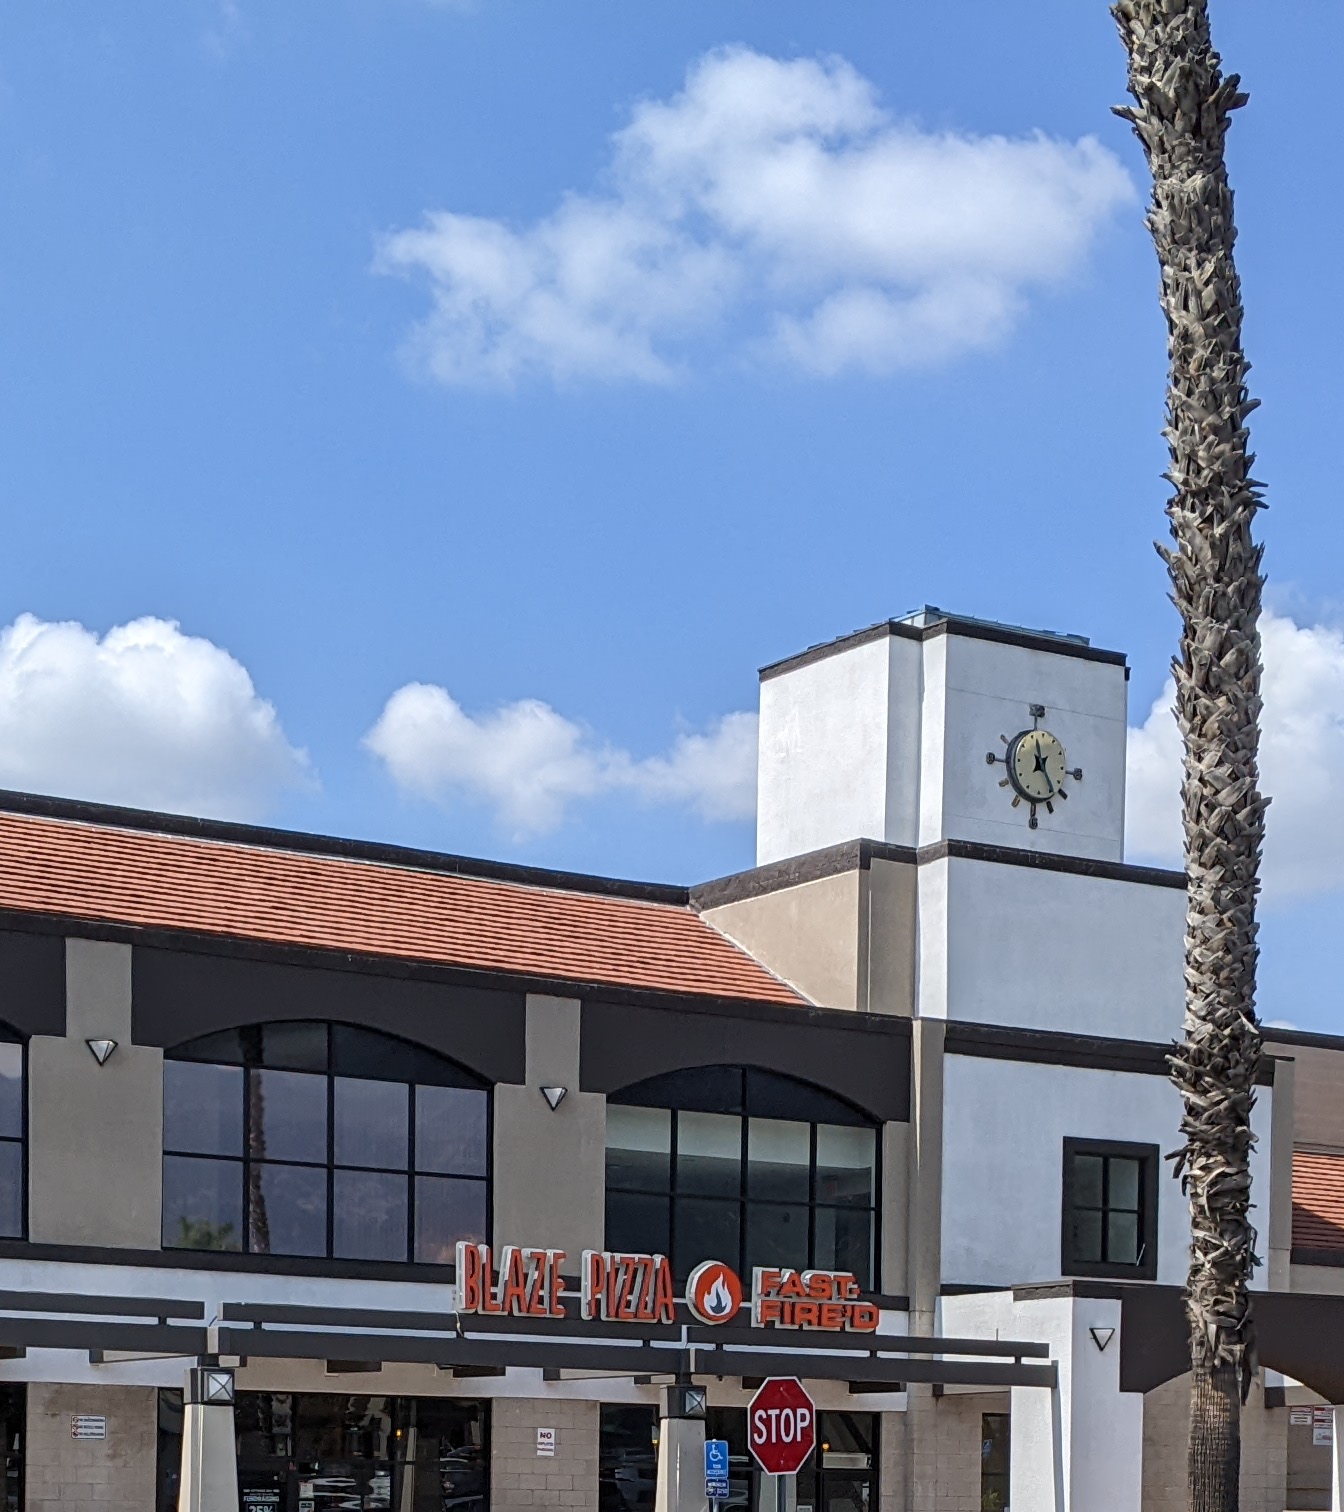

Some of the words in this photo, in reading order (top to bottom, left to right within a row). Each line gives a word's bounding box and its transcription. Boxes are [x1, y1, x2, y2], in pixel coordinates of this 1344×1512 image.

[457, 1241, 567, 1318] BLAZE
[582, 1249, 676, 1325] PIZZA
[755, 1267, 861, 1301] FAST-
[755, 1299, 880, 1332] FIRE'D
[753, 1408, 811, 1445] STOP
